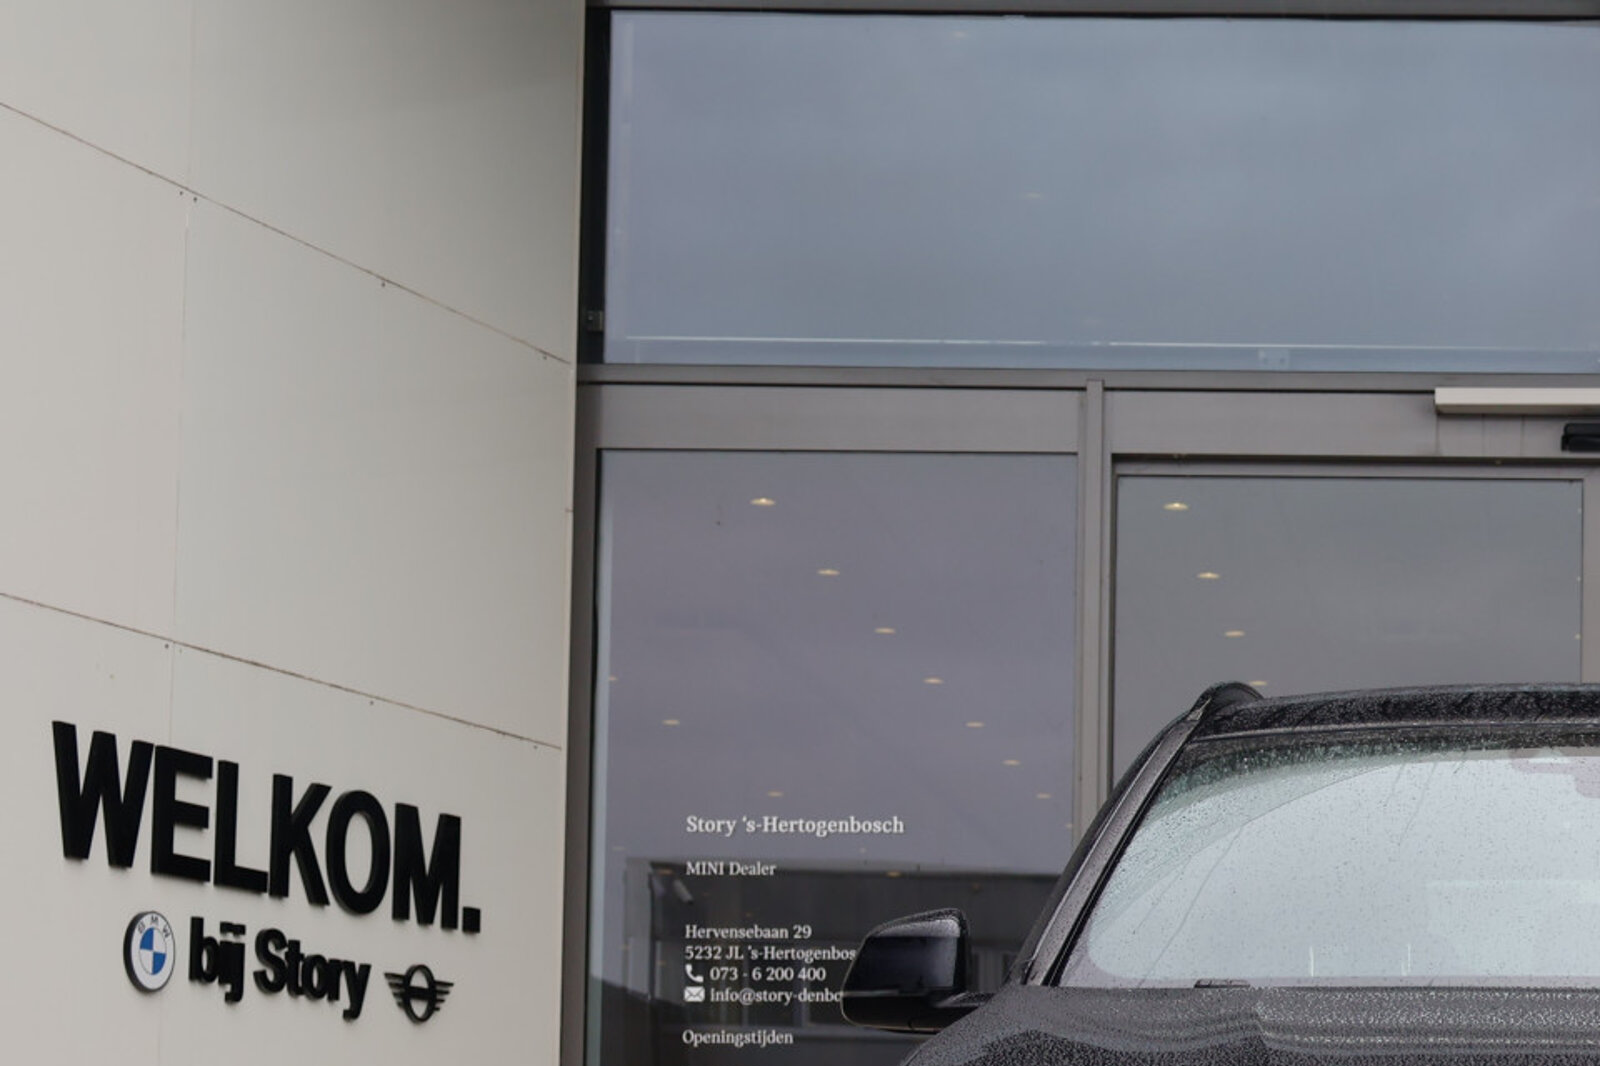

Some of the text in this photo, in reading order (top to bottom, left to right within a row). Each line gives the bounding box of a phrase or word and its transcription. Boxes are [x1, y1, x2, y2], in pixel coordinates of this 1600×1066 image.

[51, 719, 482, 934] WELKOM.
[686, 815, 737, 837] Story
[686, 861, 777, 876] MINI Dealer
[685, 924, 812, 940] Hervensebaan 29
[684, 946, 722, 960] 5232
[725, 946, 744, 960] JL
[188, 916, 372, 1022] bij Story
[710, 966, 739, 981] 073
[751, 966, 762, 981] 6
[766, 966, 794, 981] 200
[797, 966, 827, 981] 400
[710, 988, 842, 1006] info@story-denbo
[682, 1030, 794, 1048] Openingstijden
